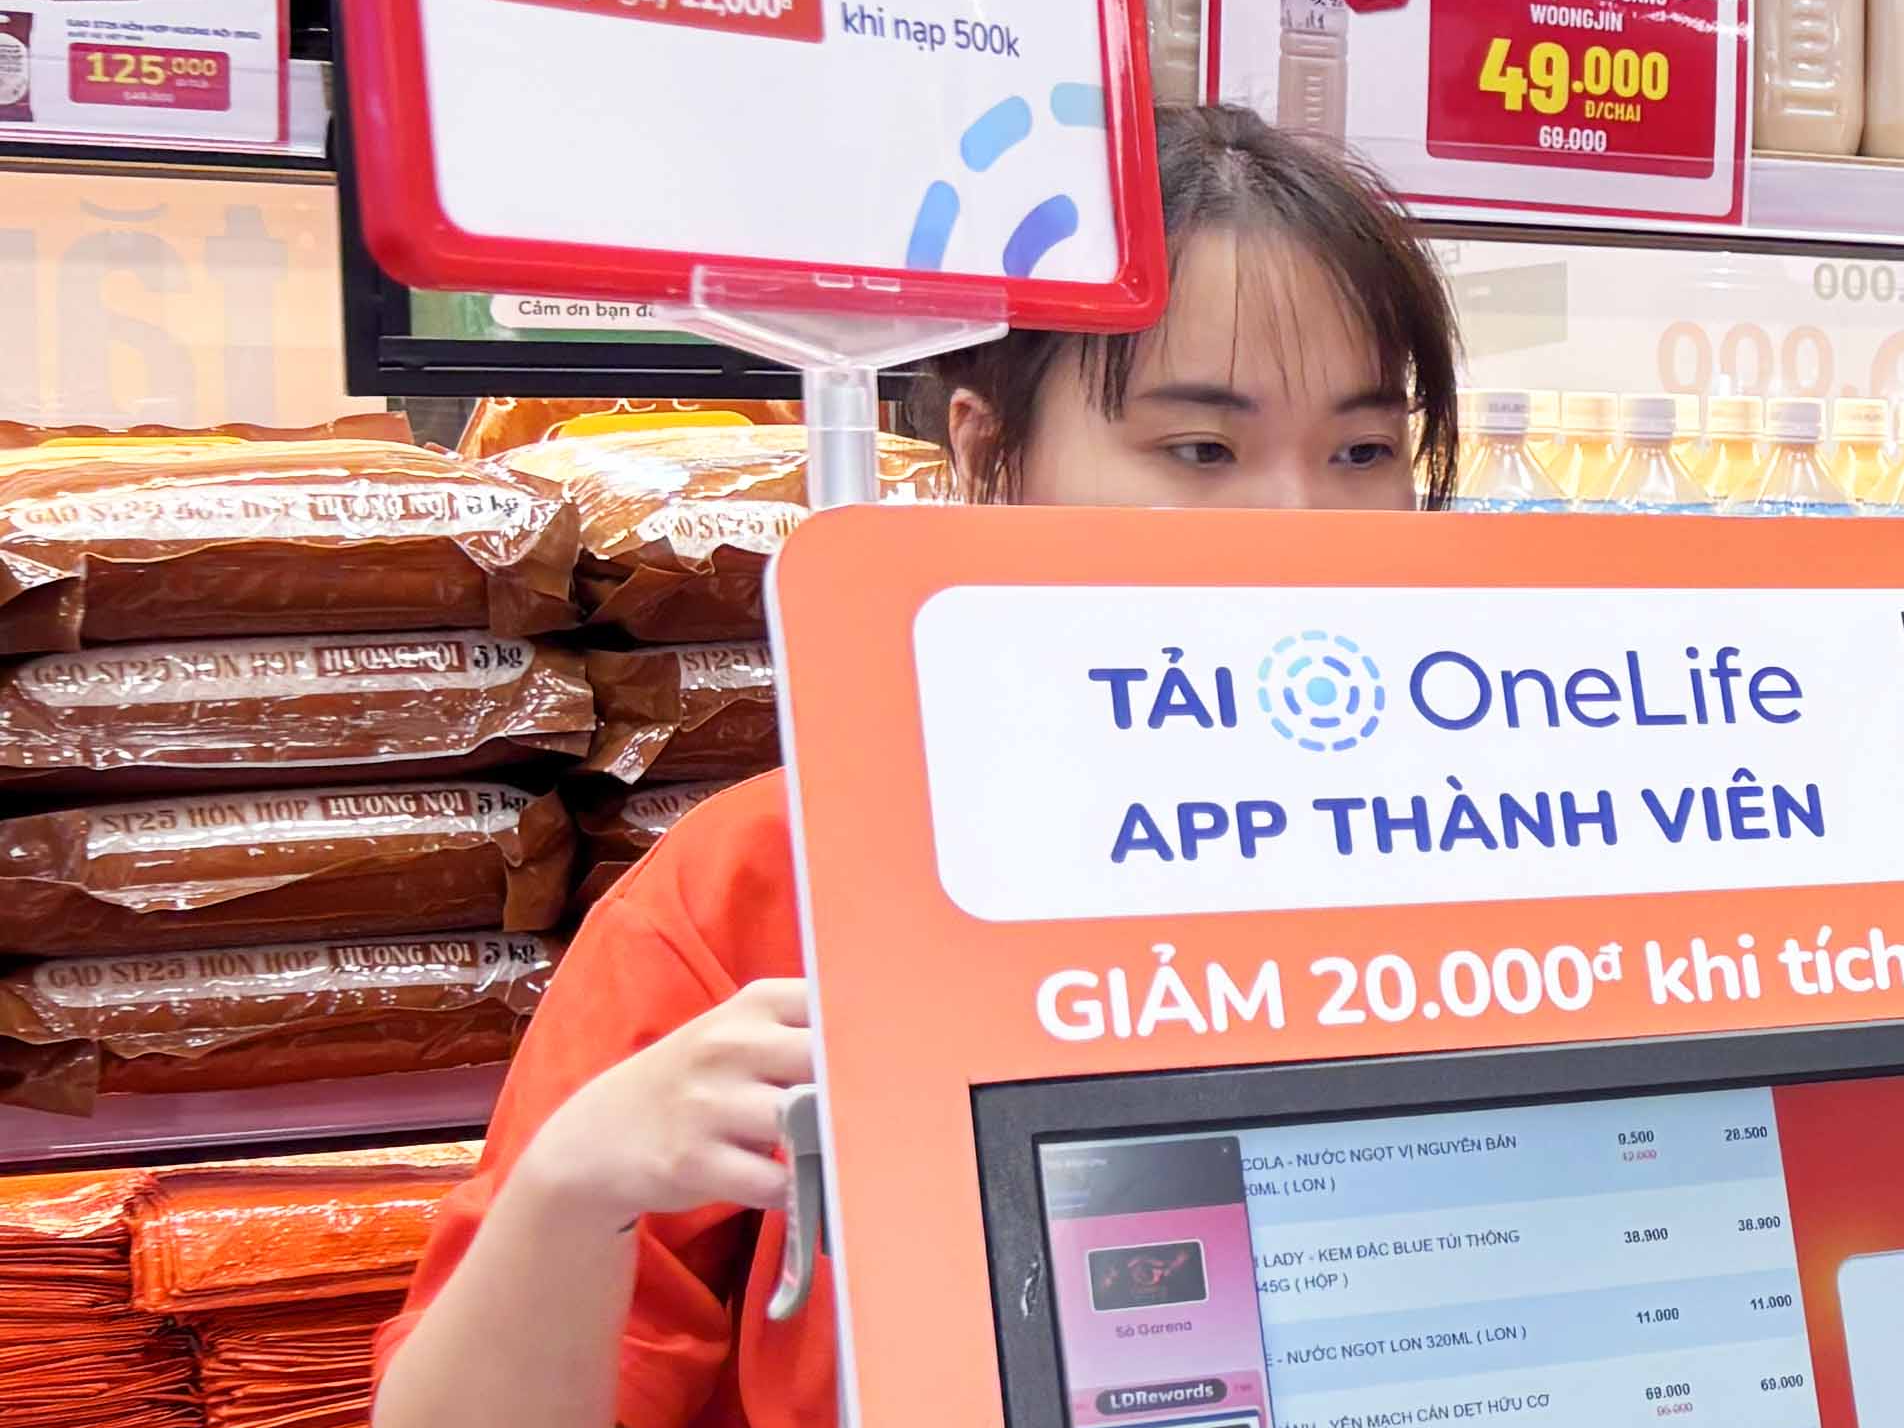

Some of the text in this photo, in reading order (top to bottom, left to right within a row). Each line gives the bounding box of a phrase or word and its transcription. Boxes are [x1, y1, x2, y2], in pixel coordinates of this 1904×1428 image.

[1531, 4, 1622, 32] WOONGJIN
[1479, 38, 1669, 114] 49.000
[1584, 100, 1641, 121] Đ/CHAI
[1088, 645, 1803, 732] TẢI OneLife
[1110, 767, 1825, 864] APP THÀNH VIÊN
[1036, 942, 1285, 1042] GIẢM
[1645, 933, 1760, 1006] khi
